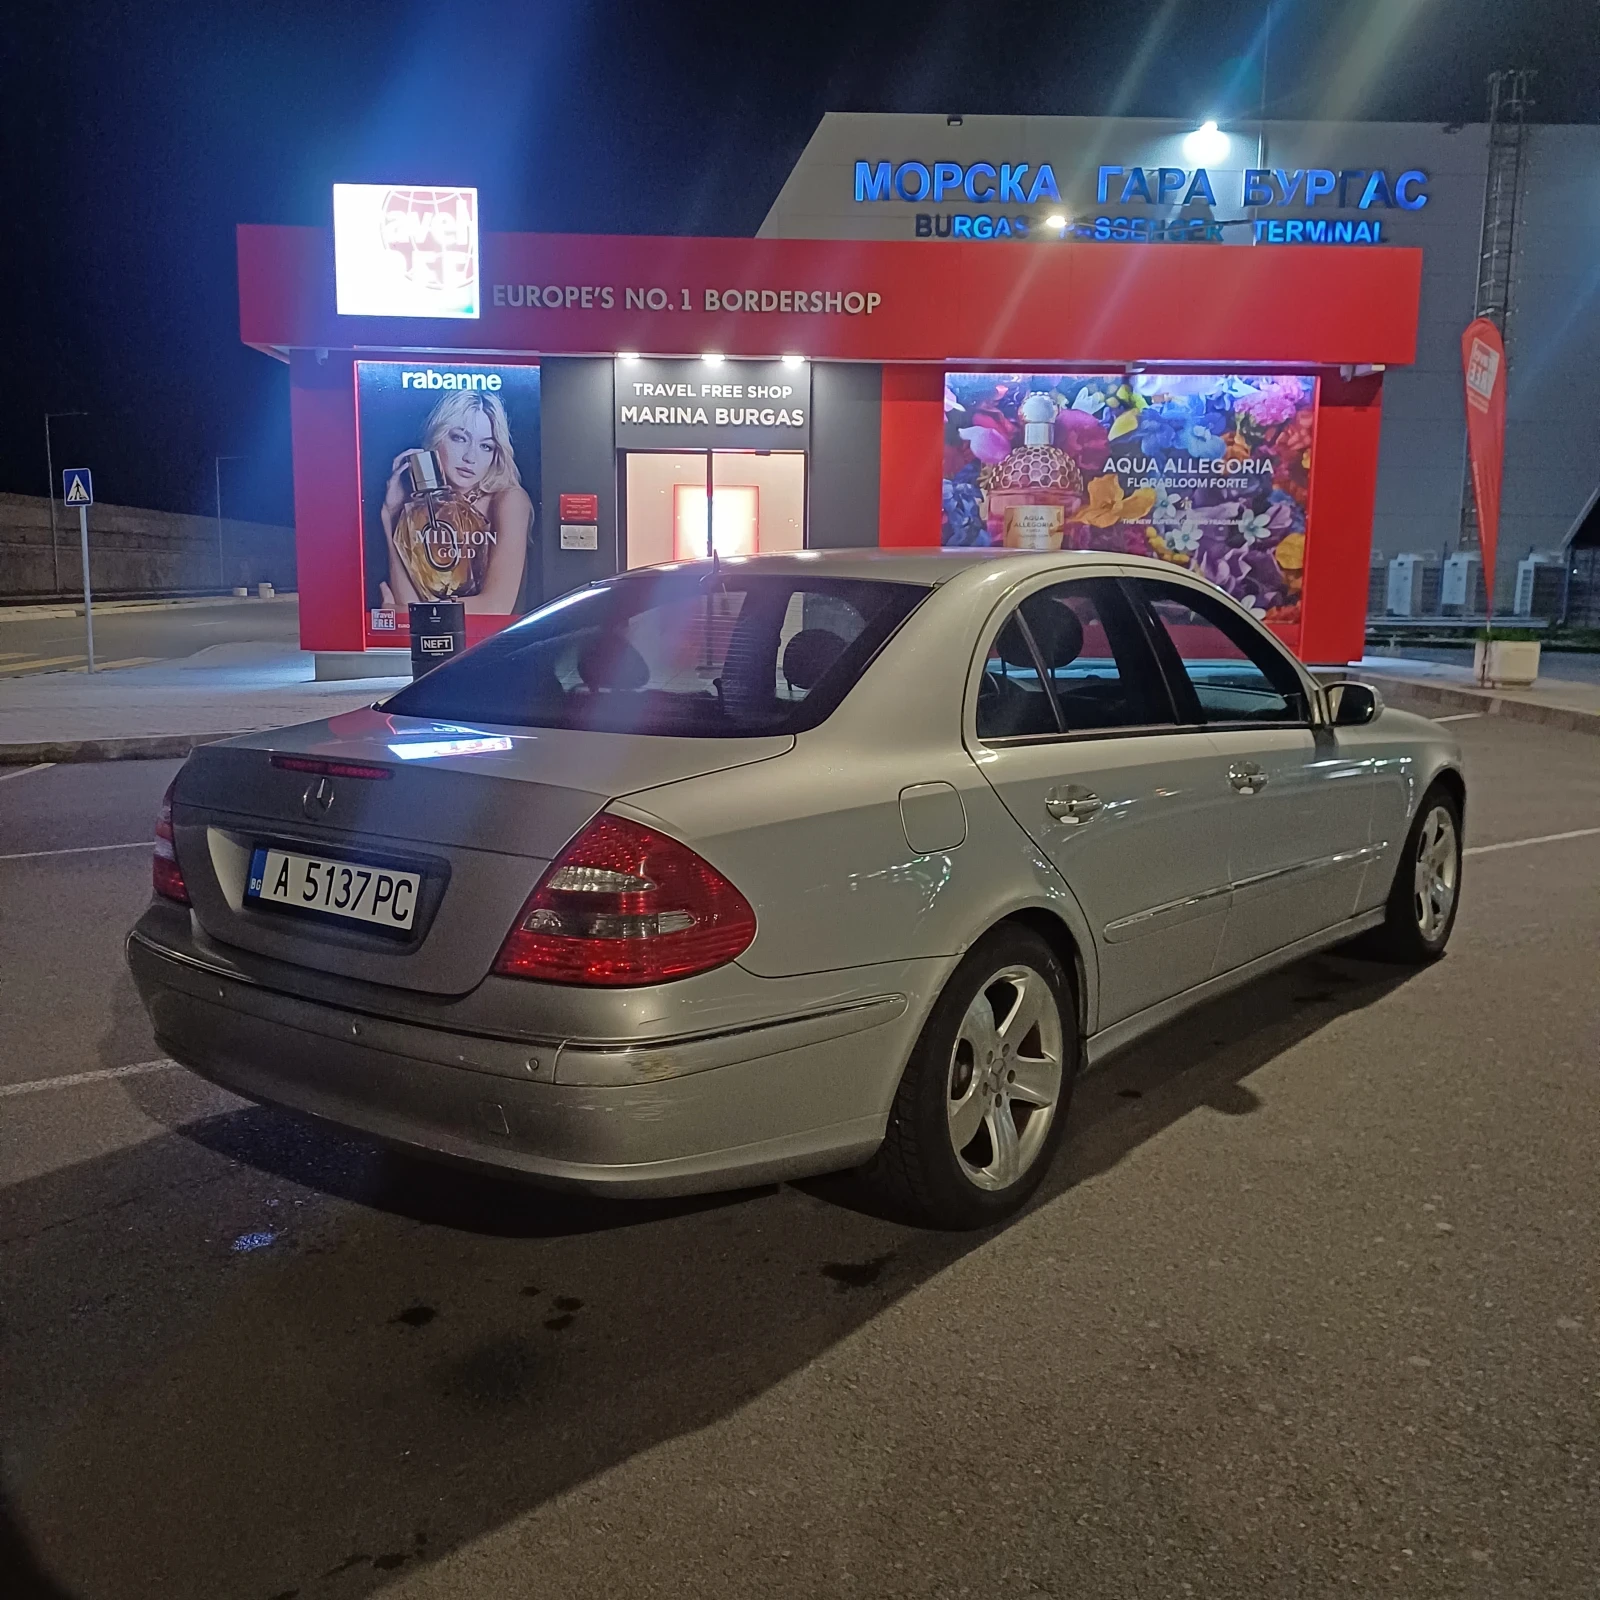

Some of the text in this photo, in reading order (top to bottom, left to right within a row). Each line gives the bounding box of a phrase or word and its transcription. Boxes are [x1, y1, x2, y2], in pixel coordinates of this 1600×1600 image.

[854, 161, 1428, 211] МОРСКА ГАРА БУРГАС
[915, 213, 1030, 240] BURGAS
[493, 284, 882, 314] EUROPE'S NO. 1 BORDERSHOP
[402, 369, 502, 391] rabanne
[633, 383, 793, 399] TRAVEL FREE SHOP
[621, 406, 804, 427] MARINA BURGAS
[1102, 457, 1274, 475] AQUA ALLEGORIA
[1127, 477, 1248, 489] FLORABLOOM FORTE
[415, 530, 497, 545] MILLION
[438, 547, 476, 559] GOLD
[373, 611, 394, 619] Travel
[373, 619, 394, 628] FREE
[423, 639, 450, 649] NEFT
[250, 878, 262, 891] BG
[273, 857, 290, 897] A
